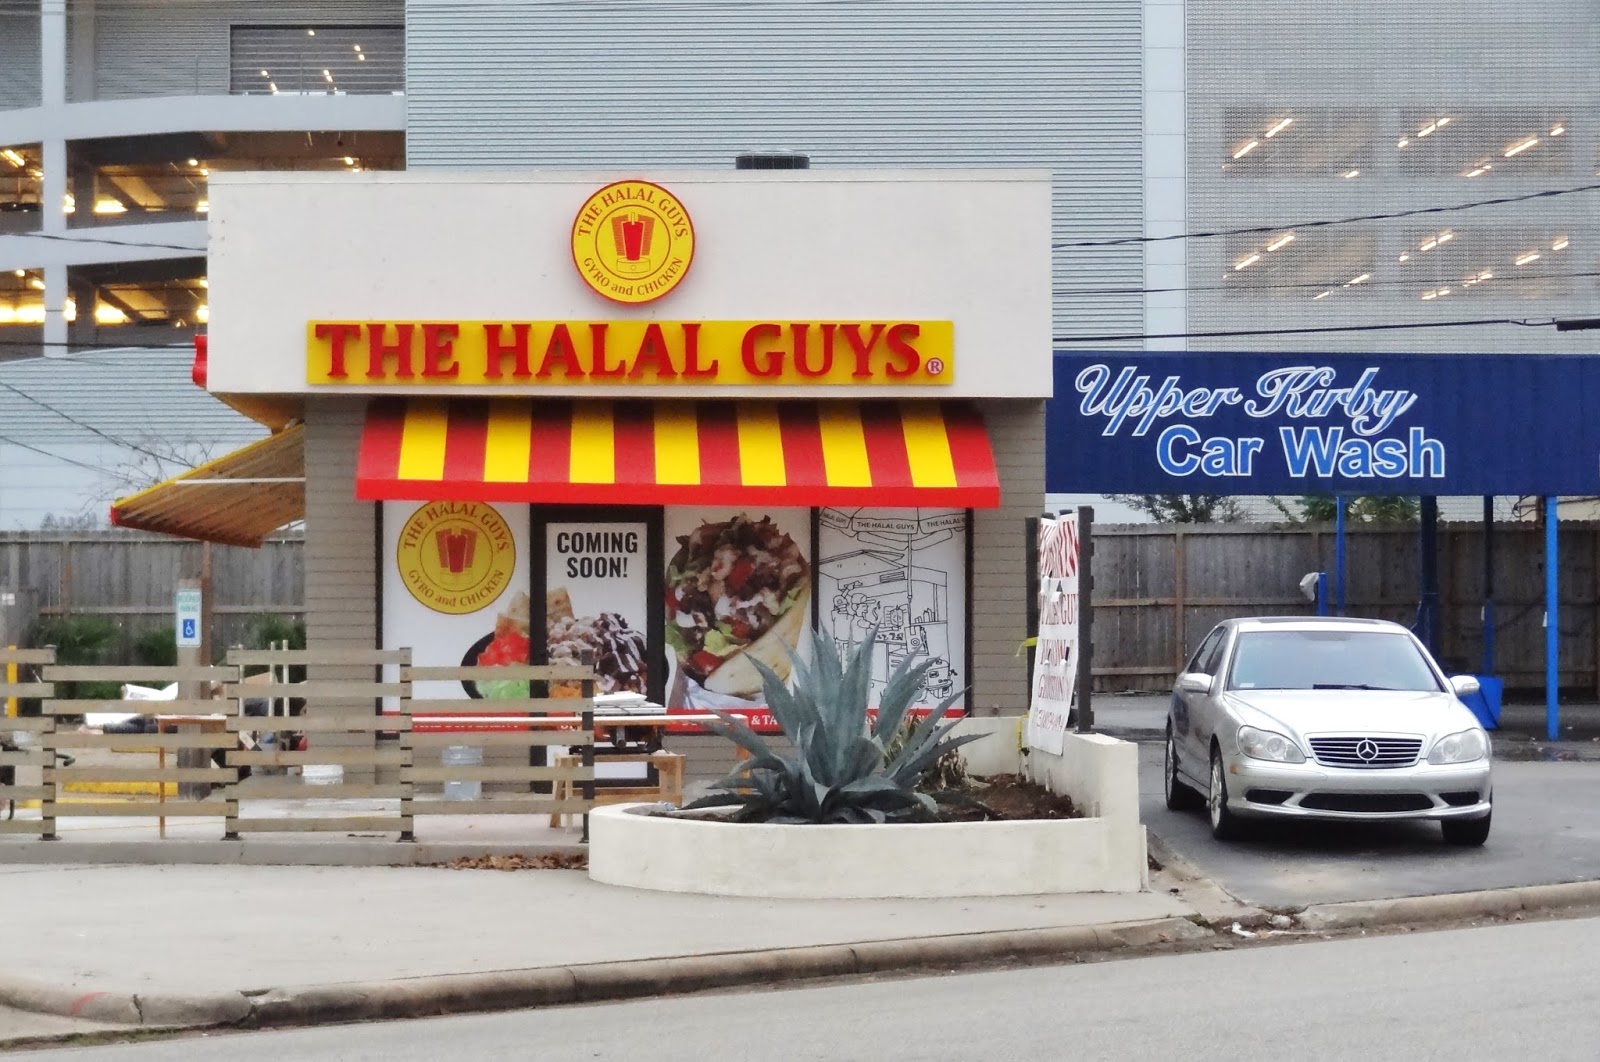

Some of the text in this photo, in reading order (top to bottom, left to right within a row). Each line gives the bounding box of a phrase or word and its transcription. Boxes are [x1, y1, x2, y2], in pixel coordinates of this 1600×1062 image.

[577, 187, 689, 238] THE HALAL GUYS
[583, 256, 683, 296] GYRO and CHICKEN
[315, 323, 459, 378] THE
[482, 323, 719, 378] HALAL
[1074, 363, 1419, 437] Upper Kirby
[1155, 424, 1446, 478] Car Wash
[403, 501, 510, 552] THE HALAL GUYS
[556, 531, 639, 554] COMING
[857, 521, 870, 529] THE
[871, 522, 895, 530] HALAL
[408, 569, 505, 607] GYRO and CHICKEN
[566, 556, 629, 579] SOON!
